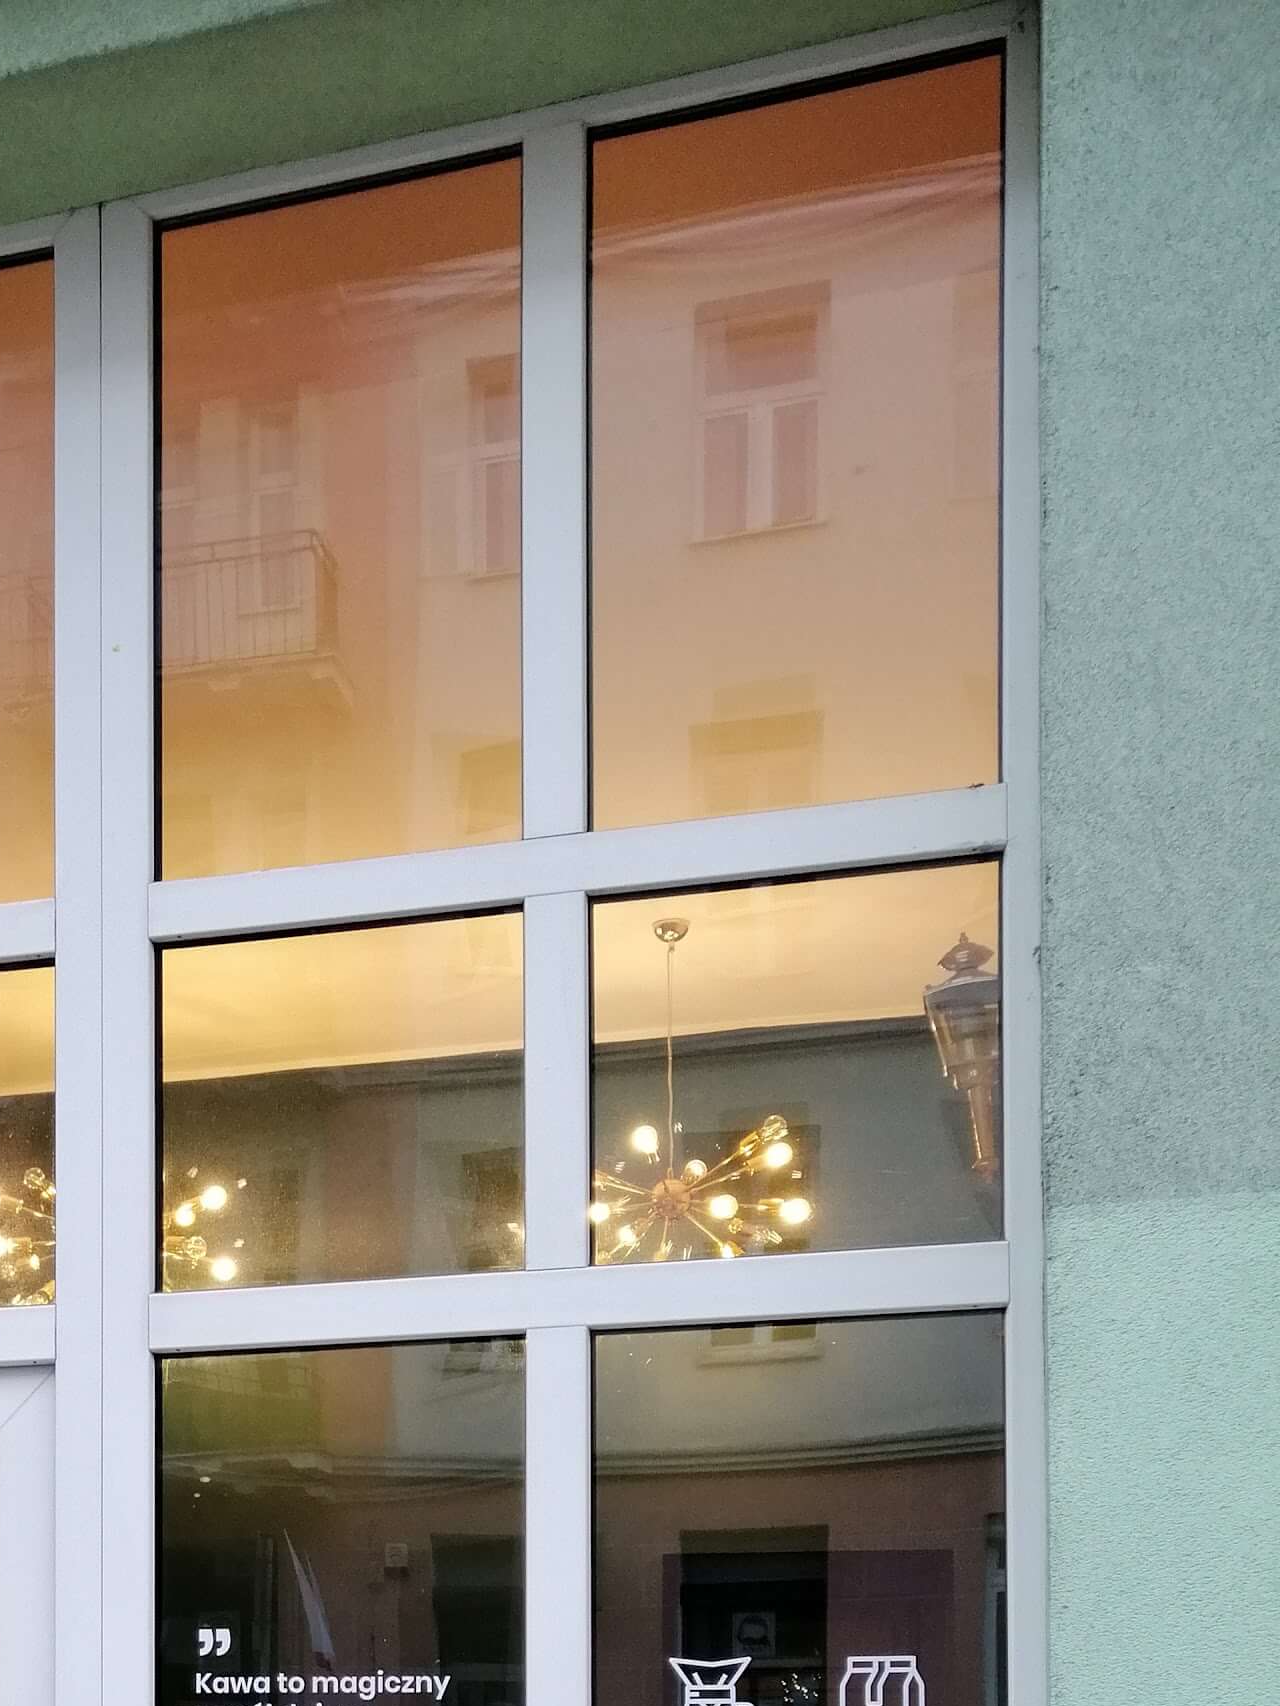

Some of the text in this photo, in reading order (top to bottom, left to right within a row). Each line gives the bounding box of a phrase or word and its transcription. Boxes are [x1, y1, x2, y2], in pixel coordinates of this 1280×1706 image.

[195, 1669, 451, 1701] Kawa to magiczny
